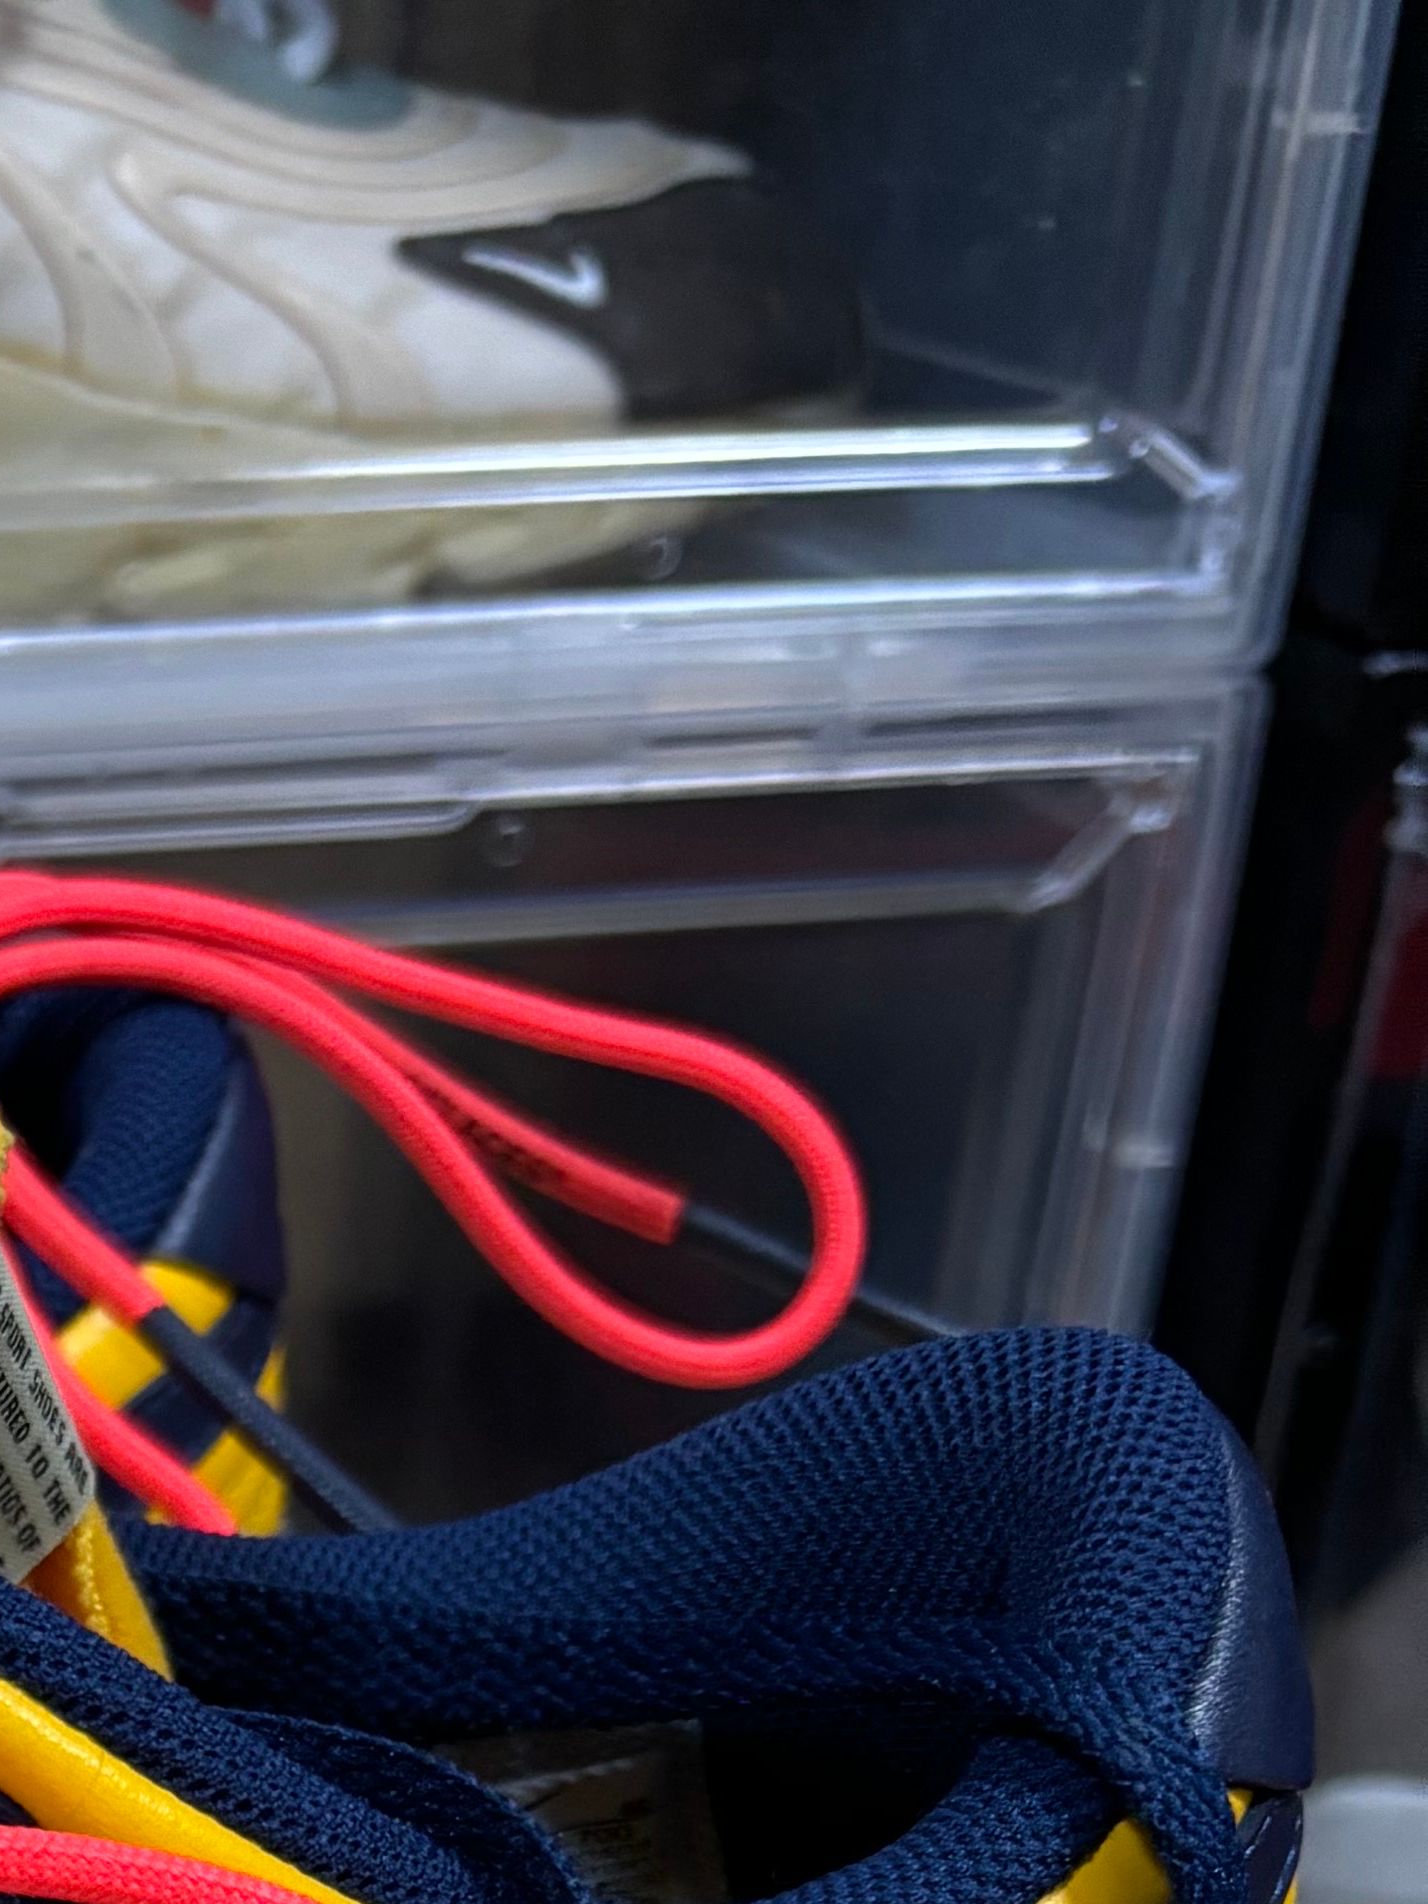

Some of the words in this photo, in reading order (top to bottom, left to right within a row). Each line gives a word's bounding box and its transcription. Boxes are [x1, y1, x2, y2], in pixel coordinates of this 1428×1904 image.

[28, 1369, 67, 1447] SHOES
[63, 1441, 89, 1496] ARE
[25, 1445, 50, 1481] TO
[46, 1478, 73, 1526] THE
[17, 1522, 43, 1552] OF
